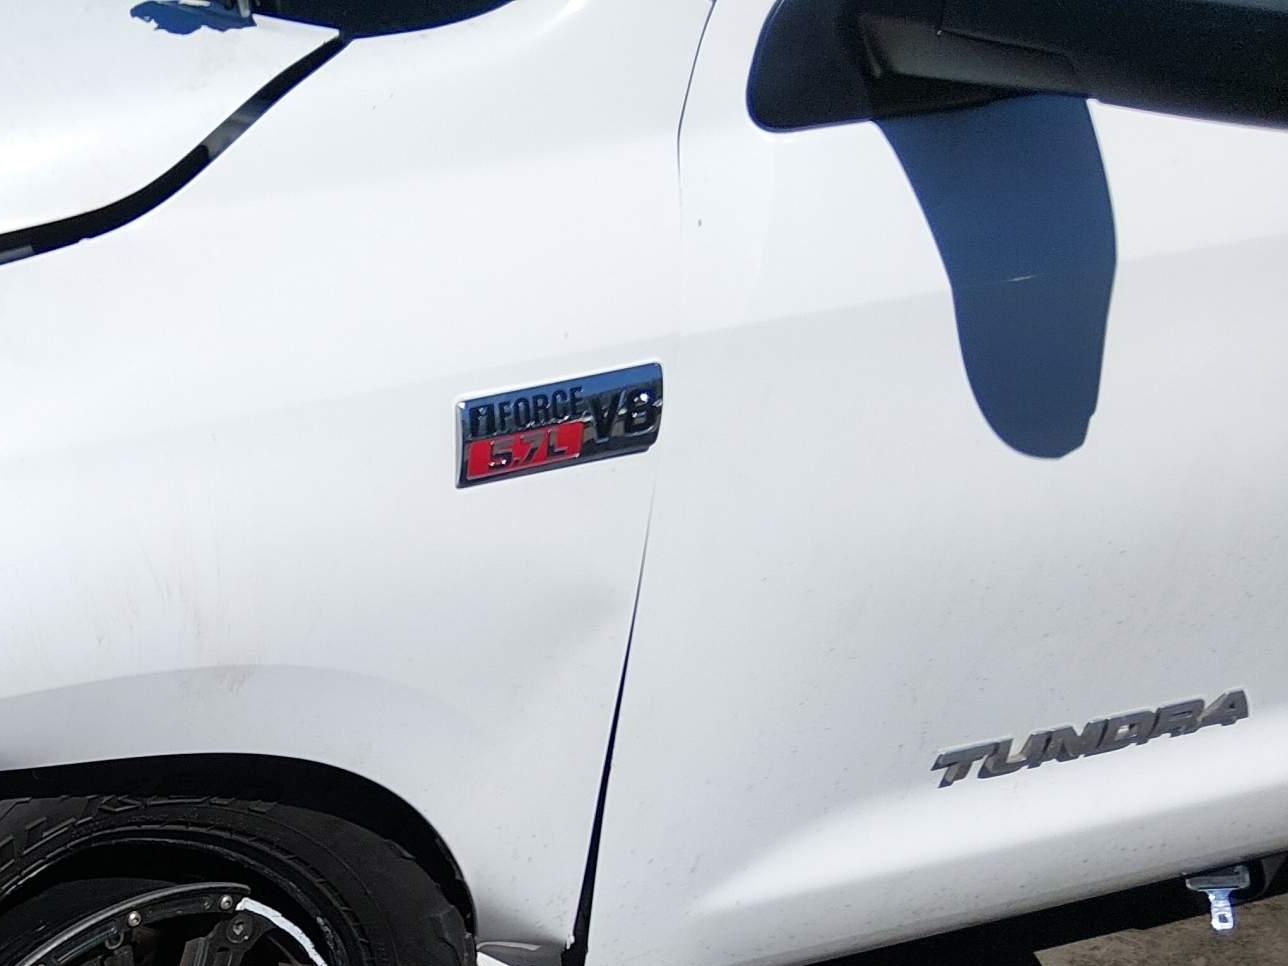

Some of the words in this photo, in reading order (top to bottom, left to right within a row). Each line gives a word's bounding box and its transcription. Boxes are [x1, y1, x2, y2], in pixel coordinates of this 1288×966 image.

[589, 386, 660, 444] V8
[488, 428, 569, 468] 5.7L
[930, 687, 1249, 788] TUNDRA
